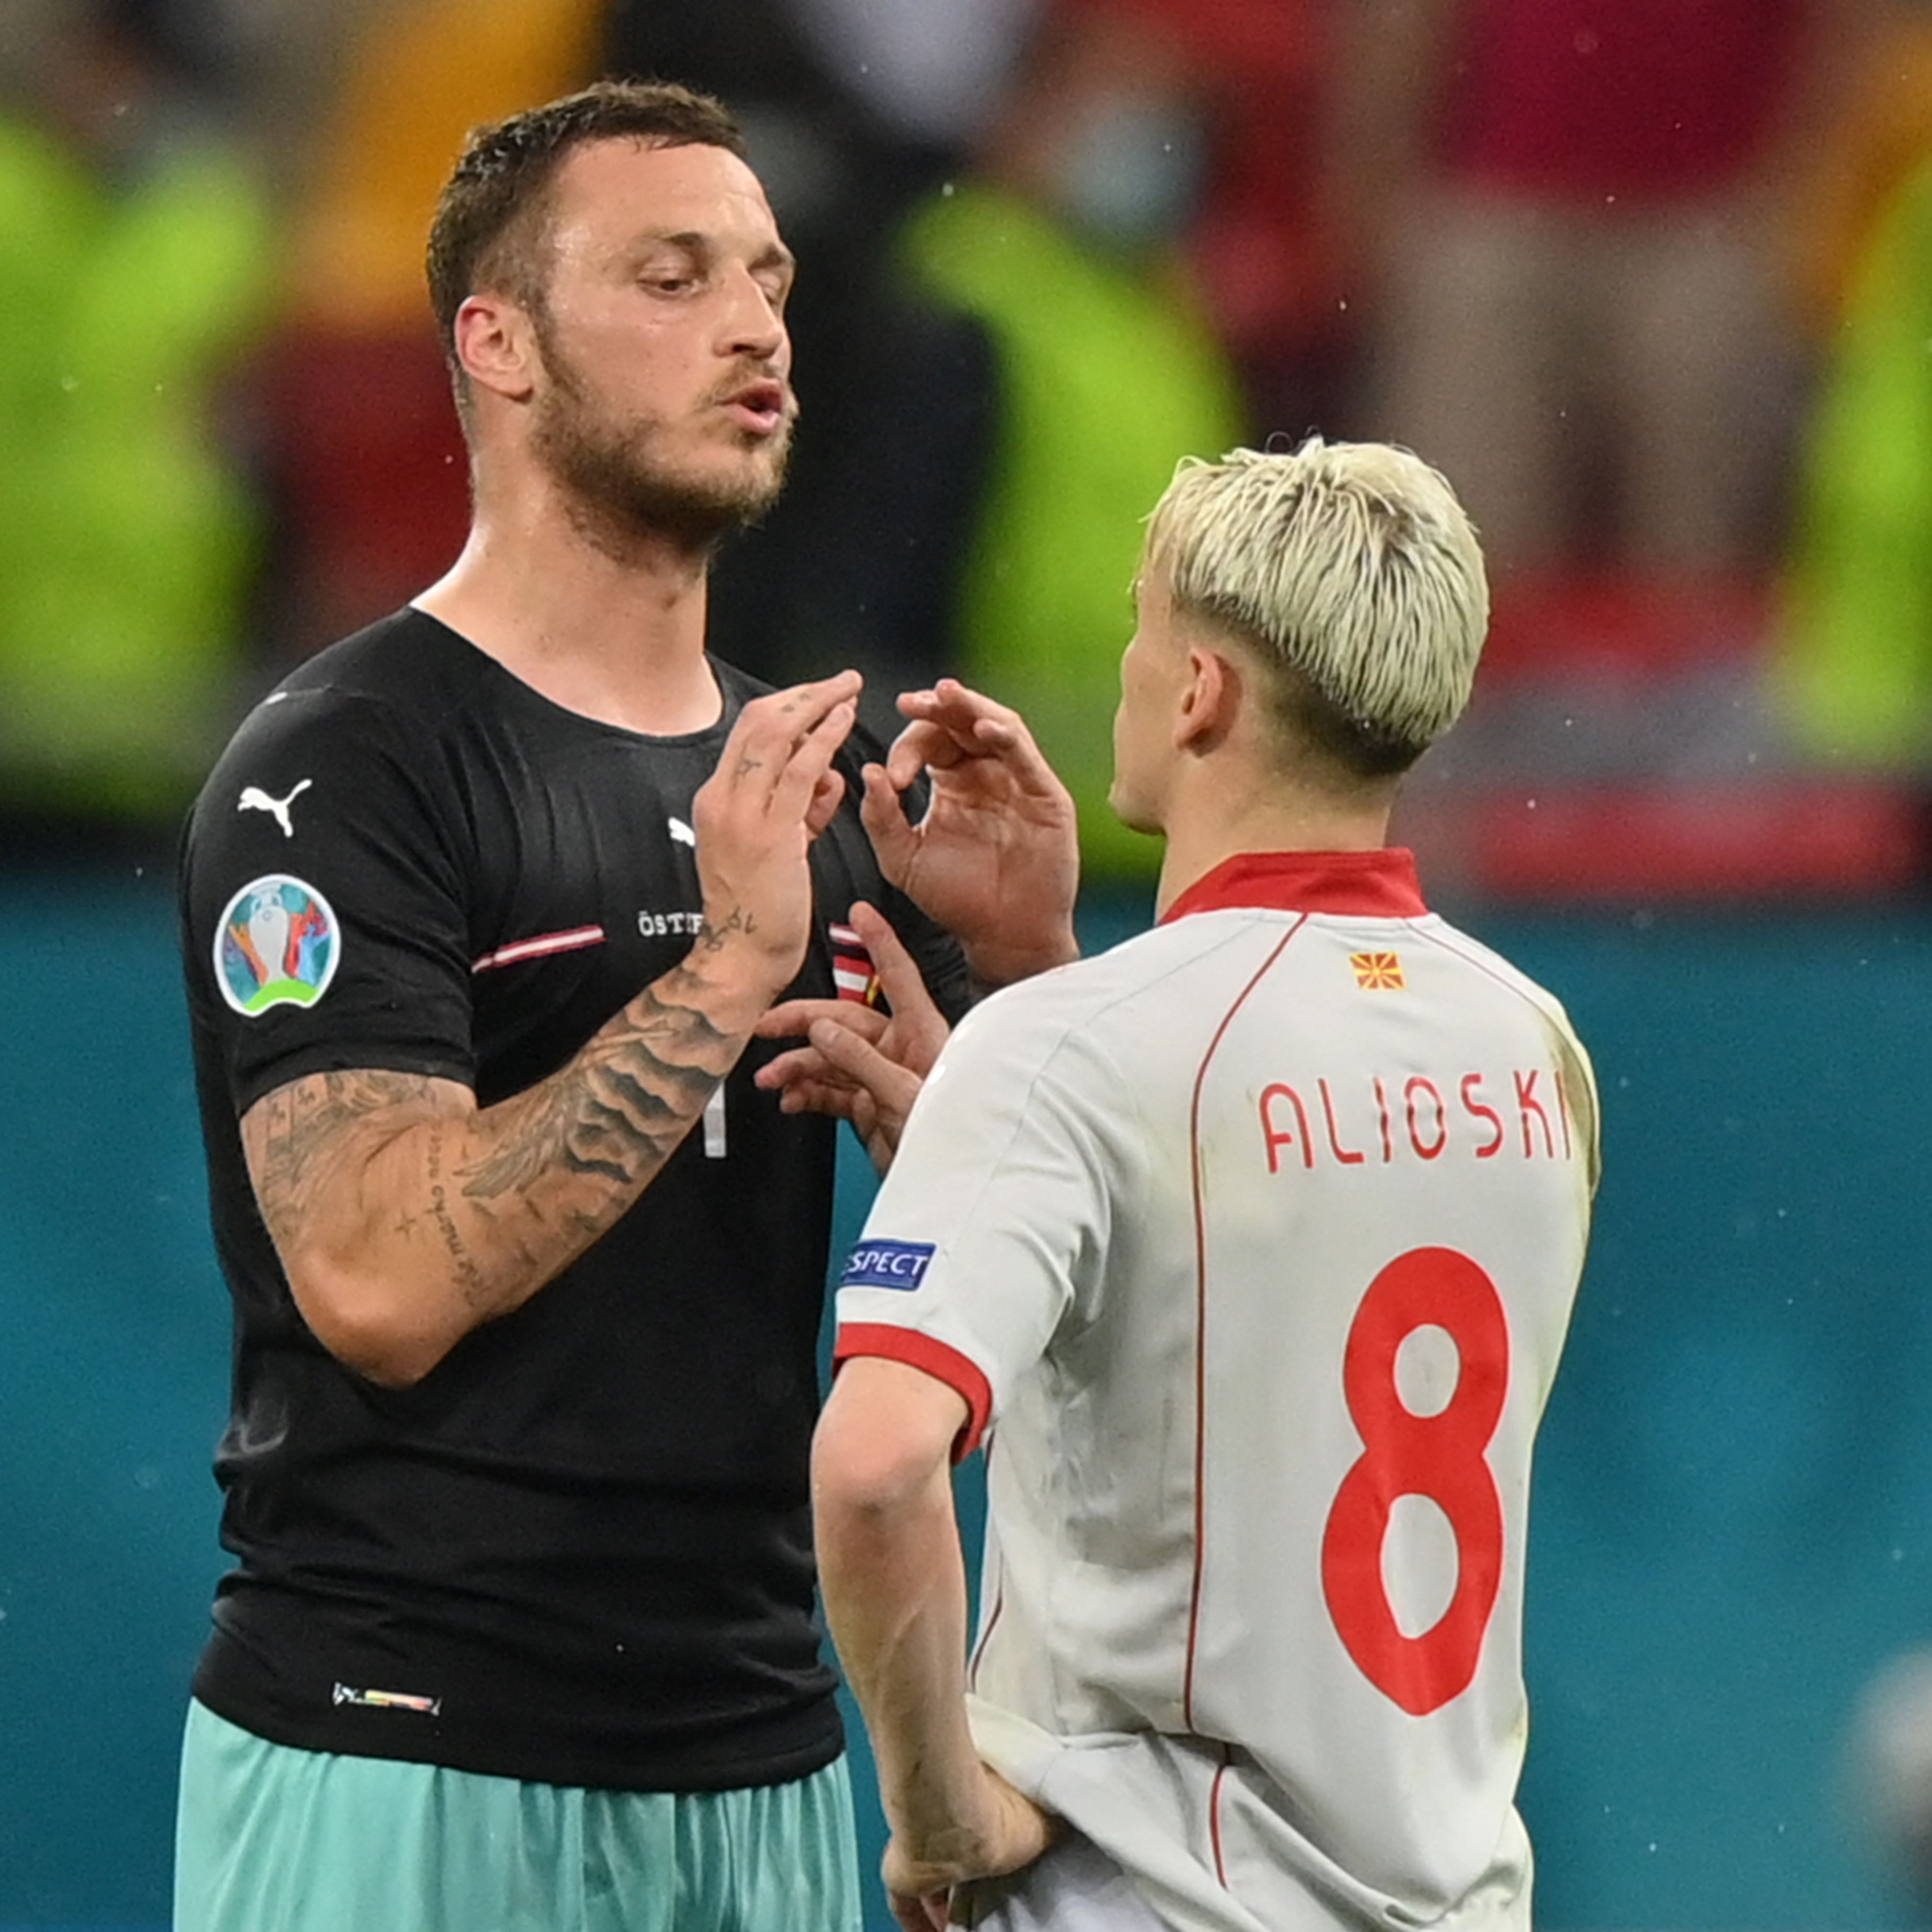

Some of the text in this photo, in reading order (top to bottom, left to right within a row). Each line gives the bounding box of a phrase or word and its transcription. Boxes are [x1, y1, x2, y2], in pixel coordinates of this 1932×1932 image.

[1259, 1070, 1571, 1174] ALIOSKI
[843, 1251, 928, 1276] SPECT
[1321, 1246, 1510, 1717] 8
